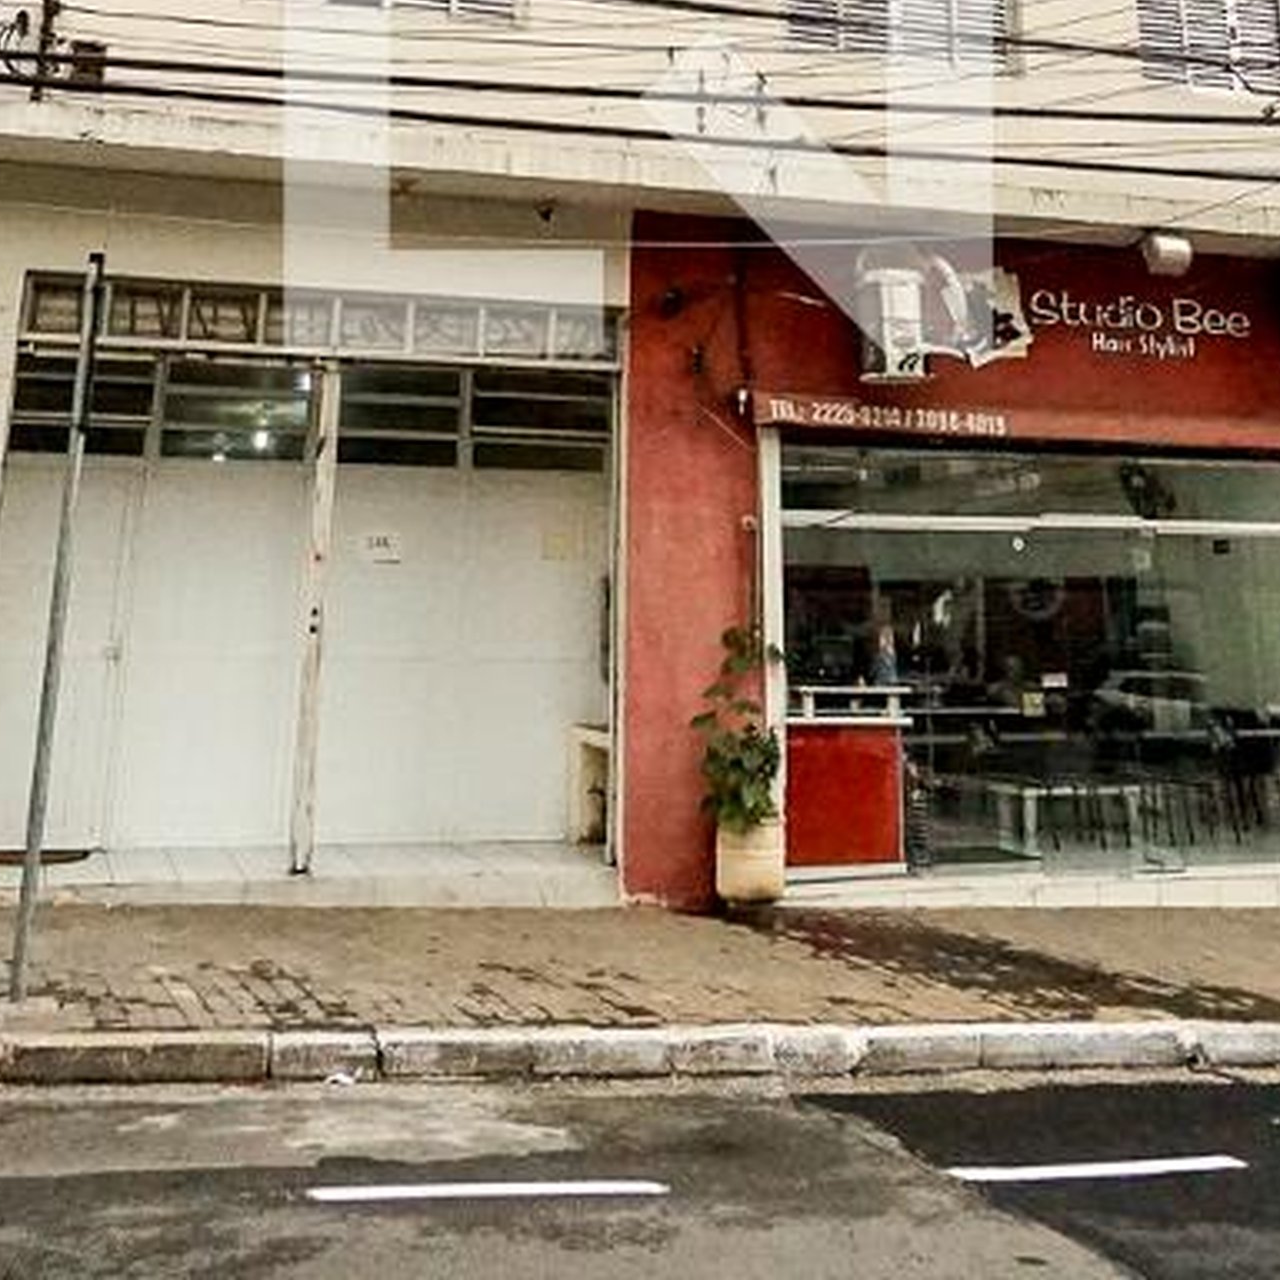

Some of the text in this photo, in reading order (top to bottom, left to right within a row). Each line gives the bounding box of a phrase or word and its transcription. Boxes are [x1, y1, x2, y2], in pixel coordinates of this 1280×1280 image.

[1030, 289, 1251, 338] Studio Bee
[1091, 332, 1196, 360] Hair Stylist
